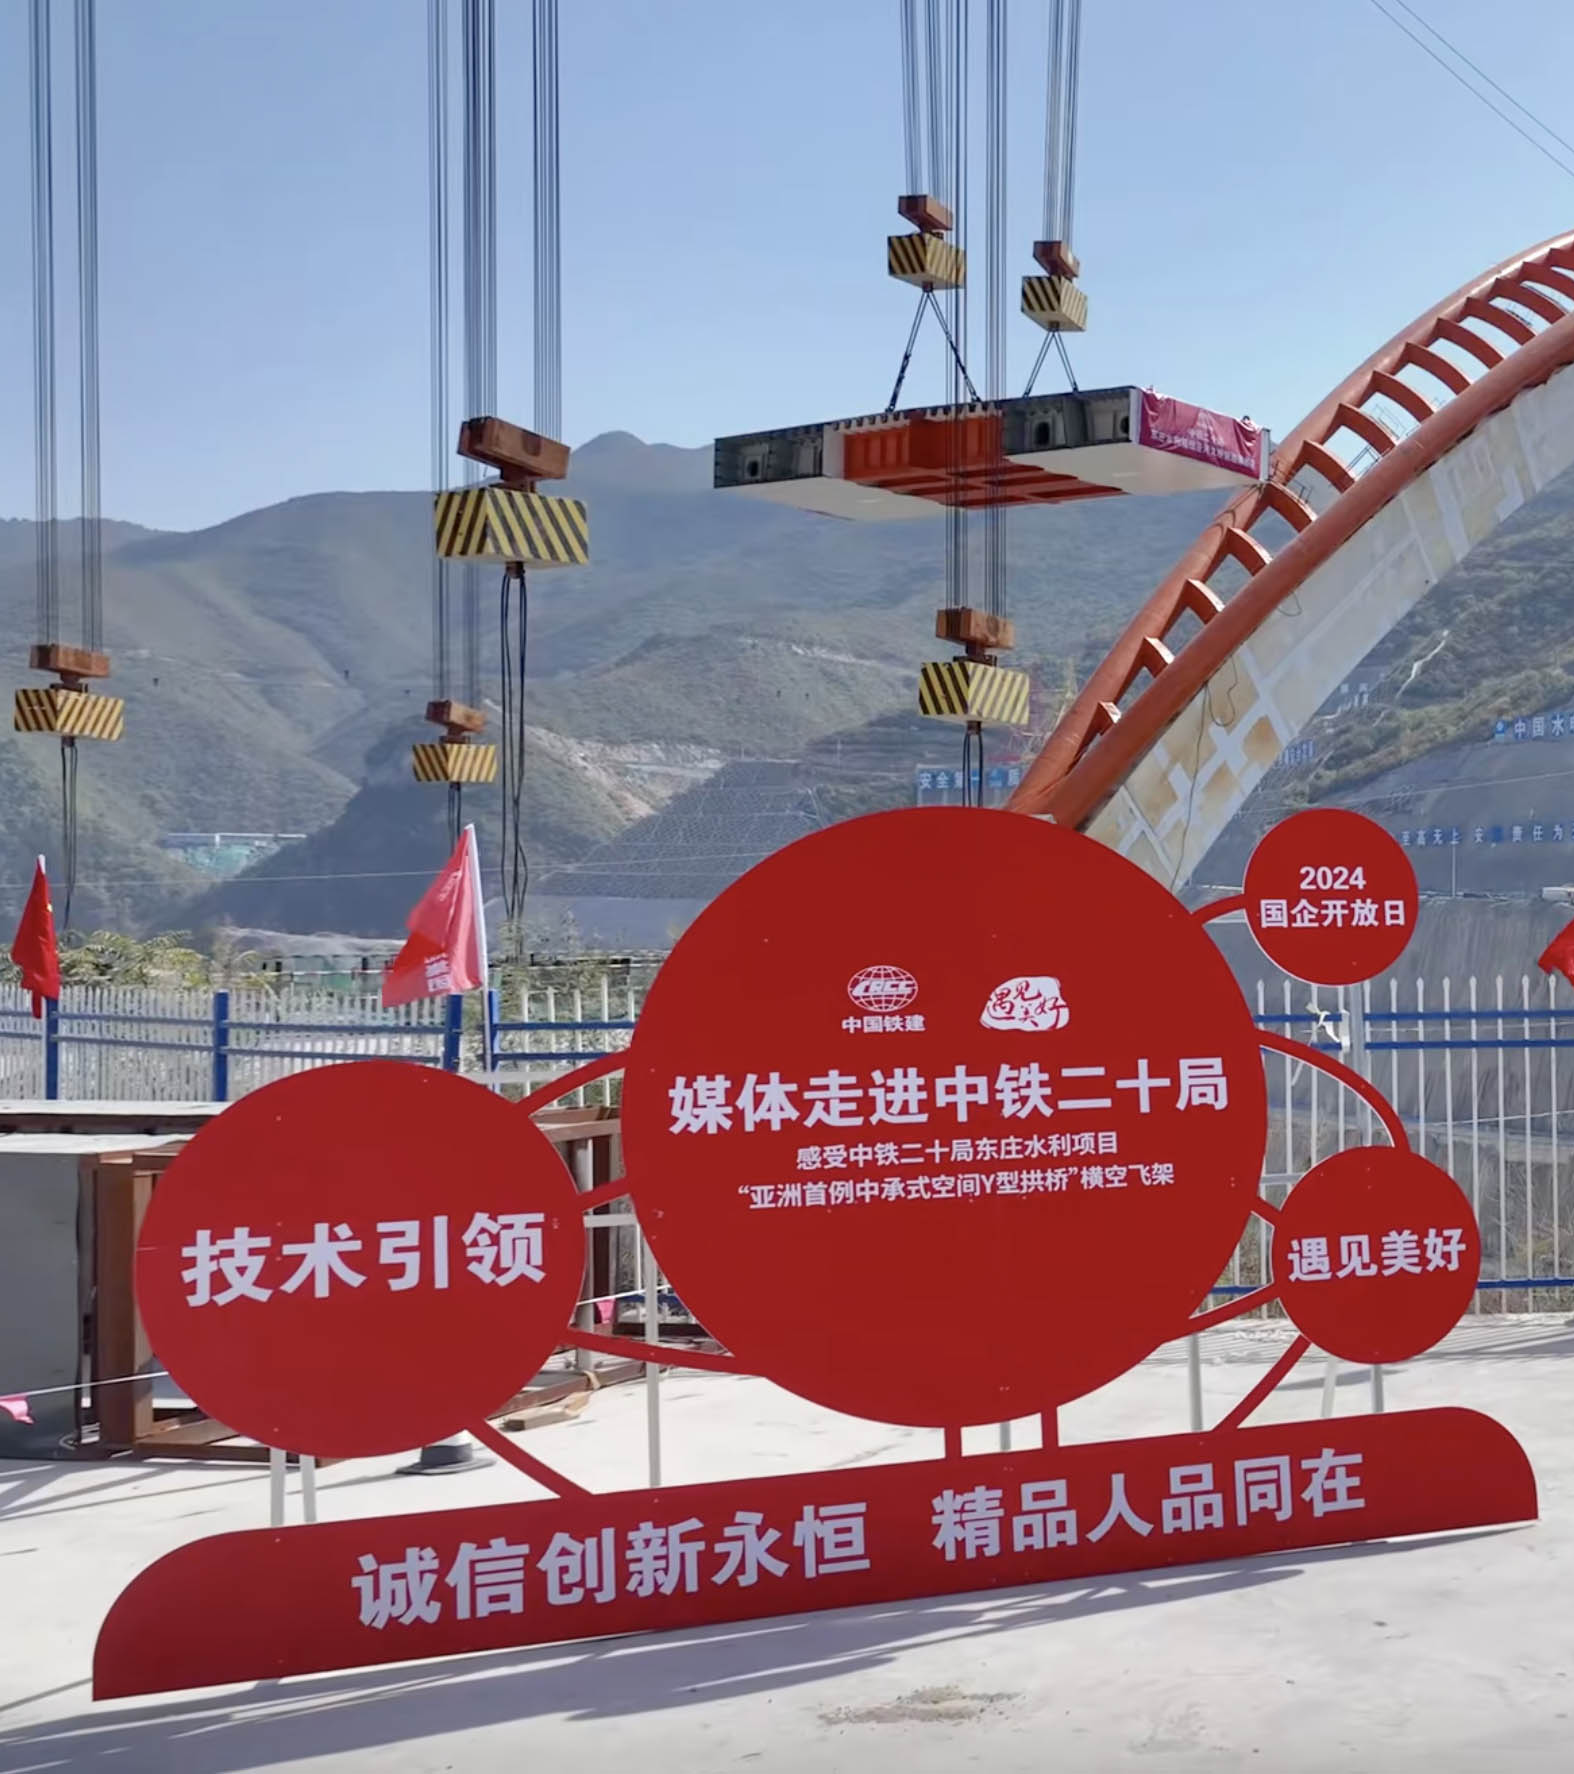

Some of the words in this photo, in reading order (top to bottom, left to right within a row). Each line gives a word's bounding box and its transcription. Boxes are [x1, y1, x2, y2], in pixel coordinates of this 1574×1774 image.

[1300, 866, 1367, 890] 2024
[1260, 898, 1406, 929] 国企开放日
[841, 1013, 926, 1034] 中国铁建
[668, 1057, 1229, 1135] 媒体走进中铁二十局
[796, 1131, 1119, 1171] 感受中铁二十局东庄水利项目
[181, 1211, 546, 1307] 技术引领
[1287, 1227, 1467, 1283] 遇见美好
[350, 1502, 871, 1630] 诚信创新永恒
[930, 1446, 1367, 1562] 精品人品同在
